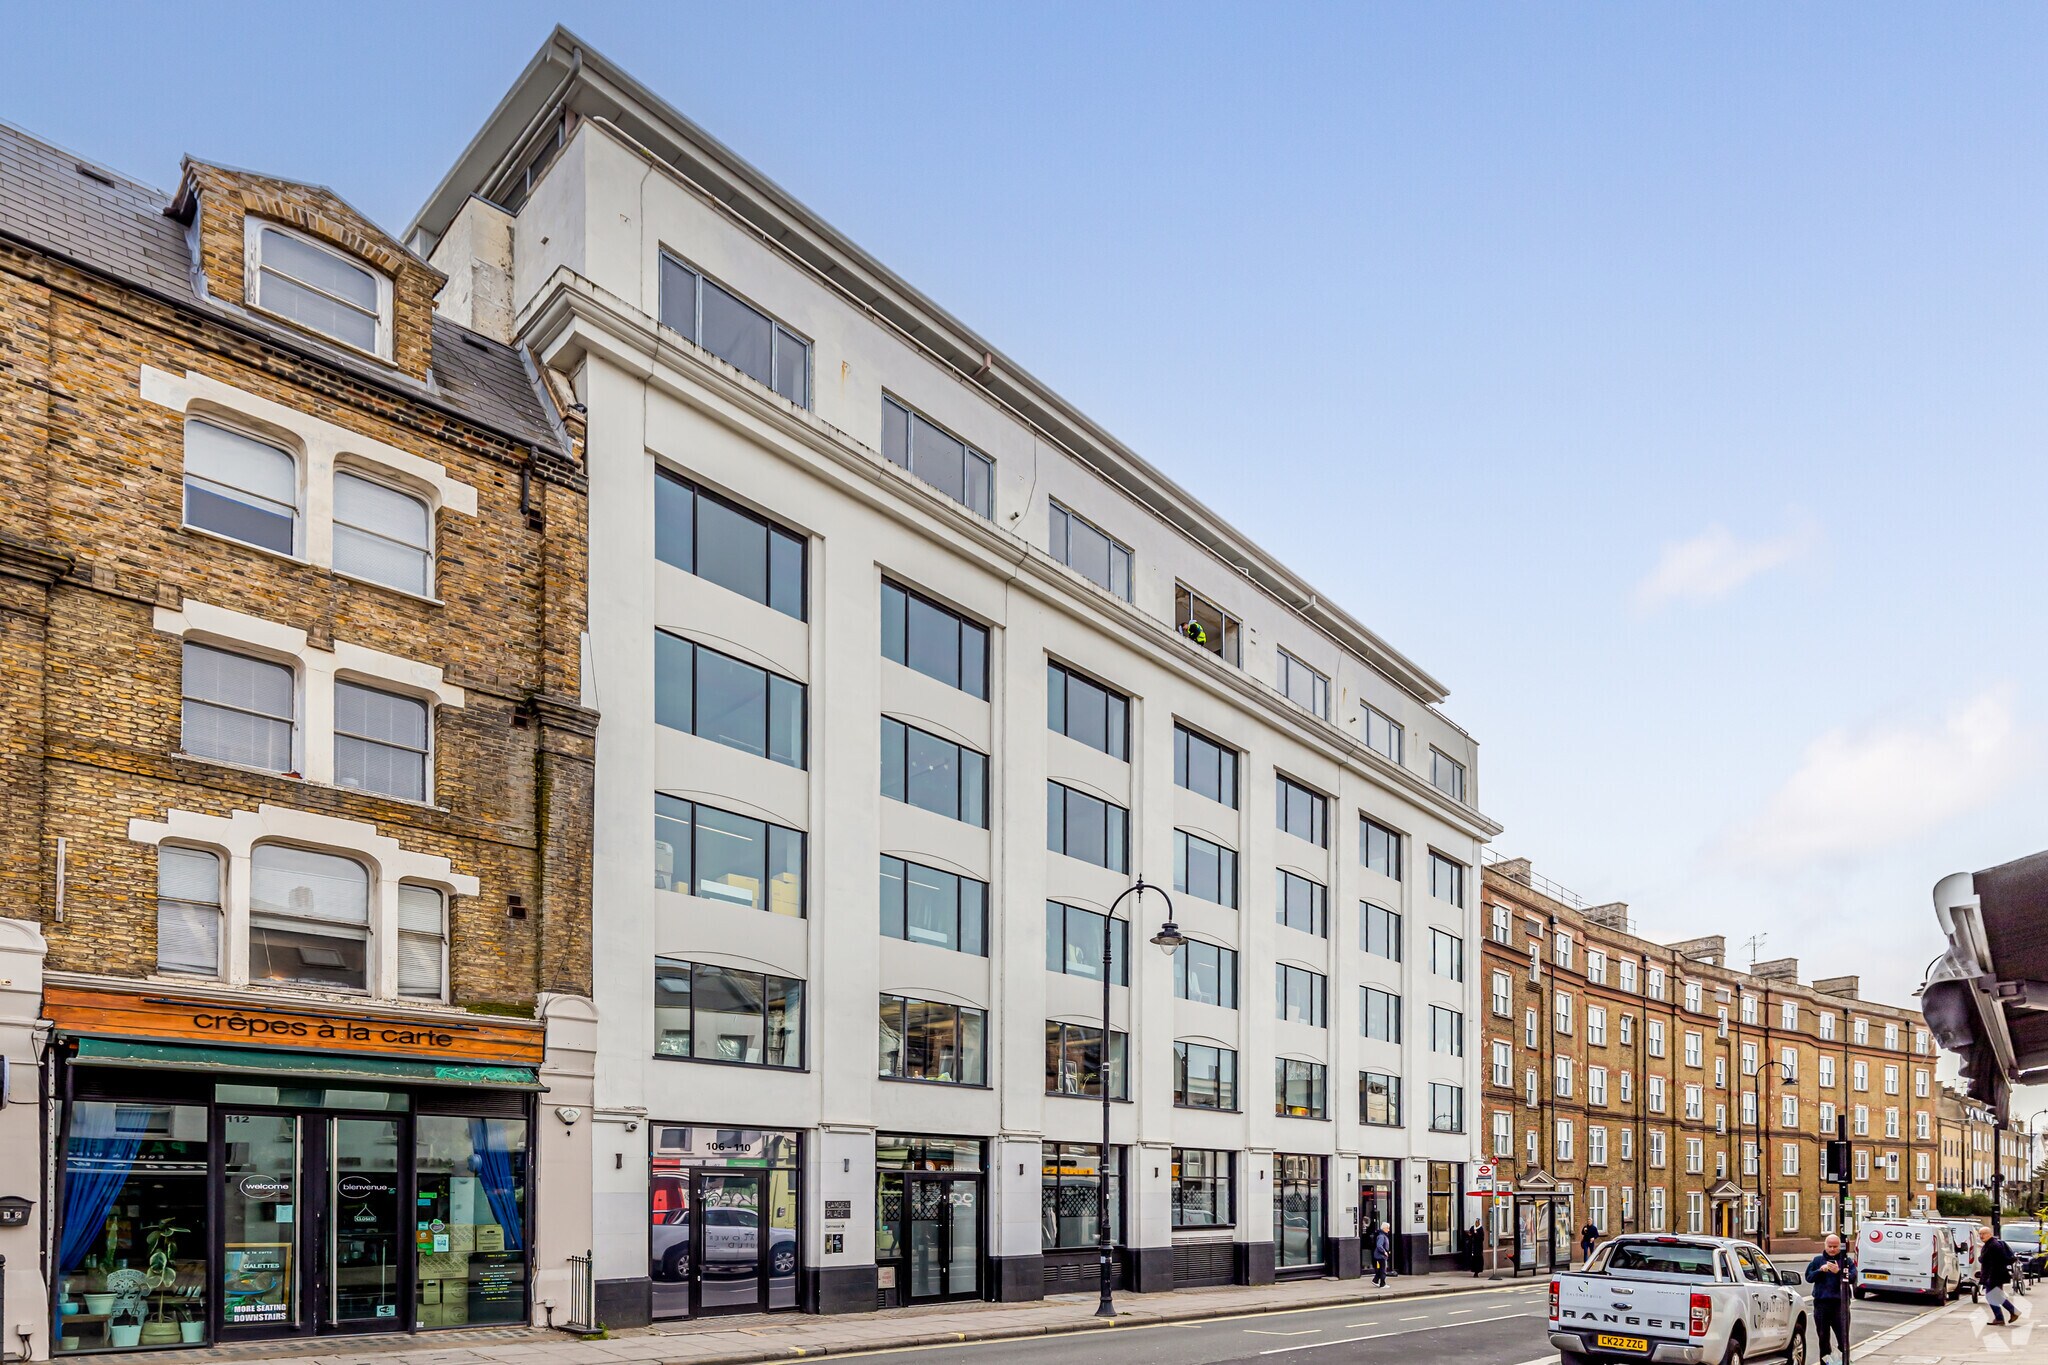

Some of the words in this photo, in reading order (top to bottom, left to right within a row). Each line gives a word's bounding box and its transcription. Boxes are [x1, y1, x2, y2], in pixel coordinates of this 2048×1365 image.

[193, 1012, 308, 1037] crêpes
[317, 1019, 336, 1040] à
[347, 1022, 371, 1042] la
[381, 1027, 453, 1047] carte
[226, 1115, 250, 1124] 112
[706, 1142, 725, 1150] 106
[734, 1143, 751, 1151] 110
[826, 1210, 844, 1218] PLACE
[1886, 1231, 1921, 1240] CORE
[257, 1303, 287, 1312] SEATING
[234, 1312, 287, 1322] DOWNSTAIRS
[1562, 1309, 1686, 1331] RANGER
[1601, 1336, 1625, 1347] CK22
[1626, 1338, 1644, 1349] ZZG
